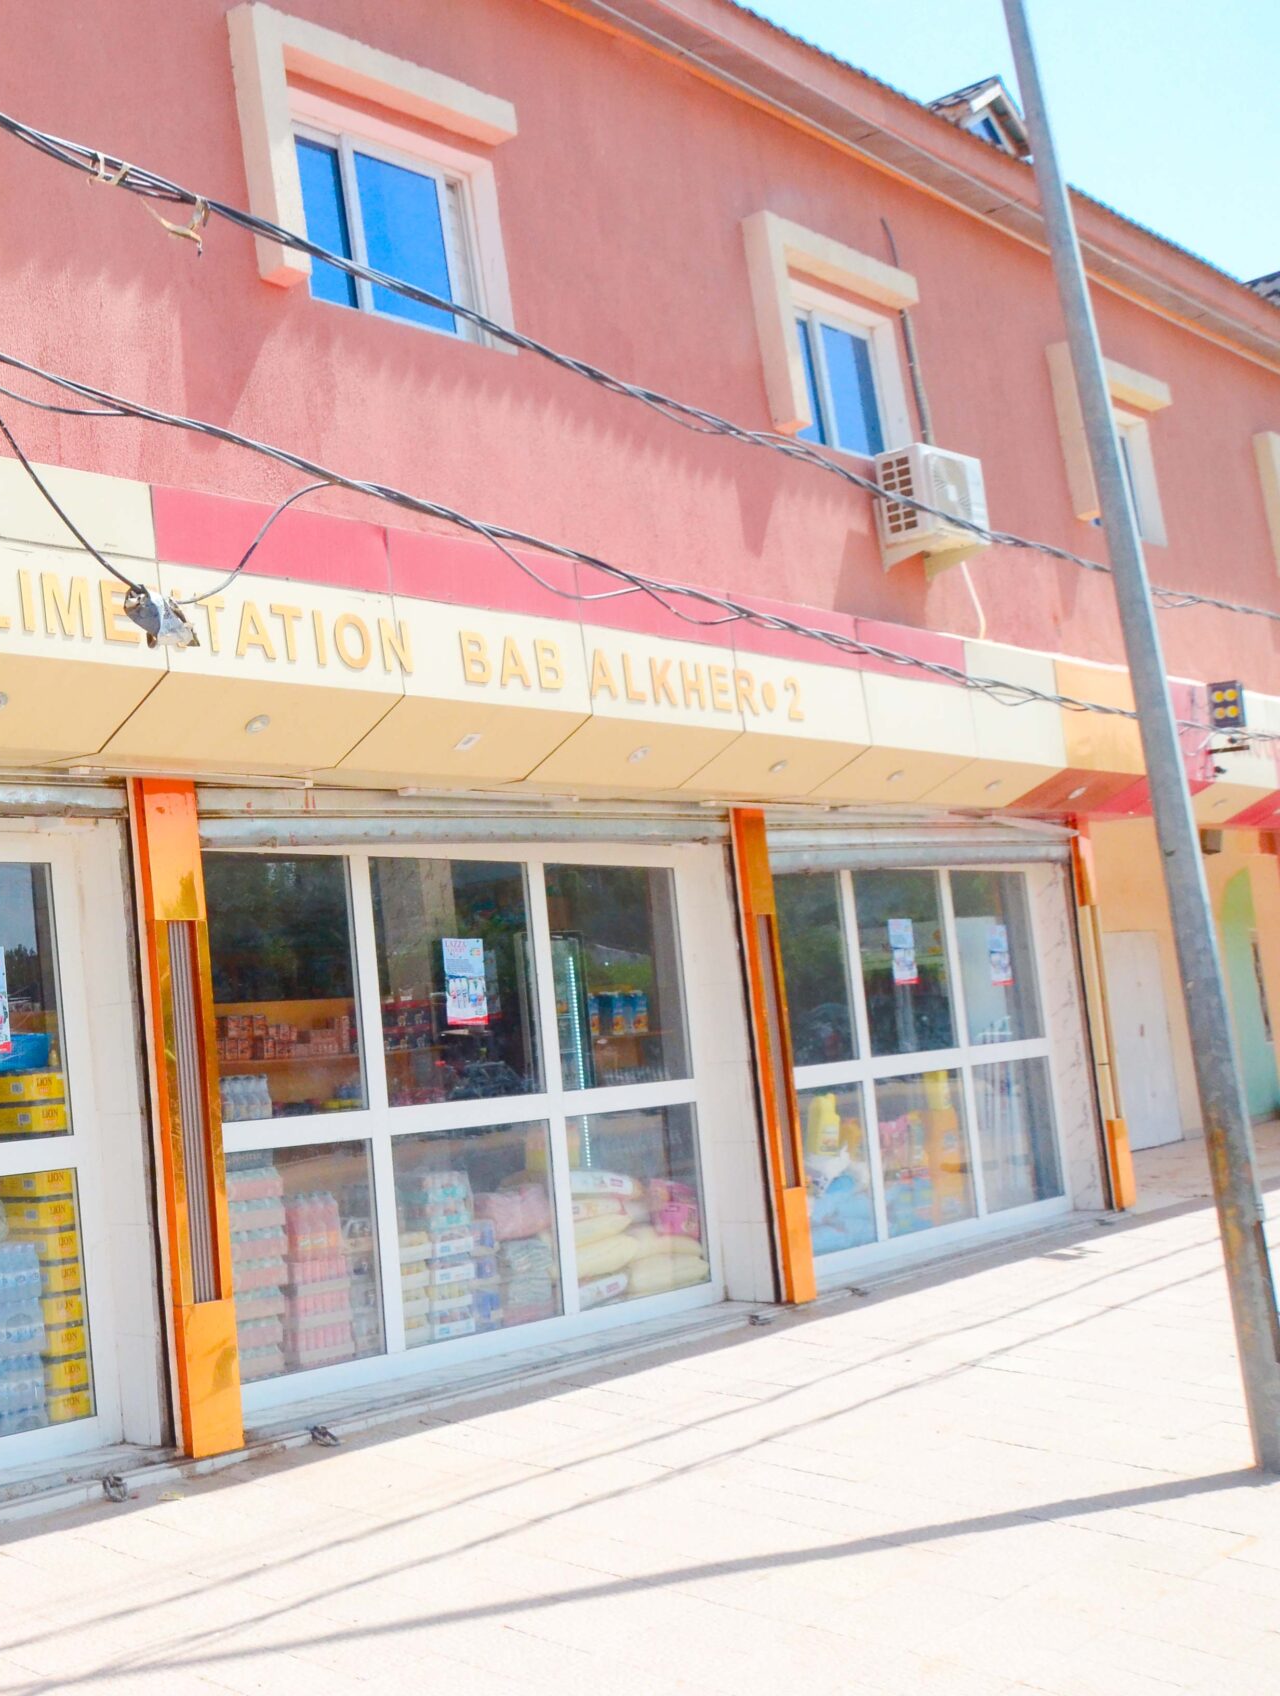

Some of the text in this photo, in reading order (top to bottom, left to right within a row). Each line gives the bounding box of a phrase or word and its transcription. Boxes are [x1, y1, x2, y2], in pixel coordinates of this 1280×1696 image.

[459, 630, 565, 690] BAB
[590, 648, 760, 716] ALKHER
[36, 1077, 53, 1087] LION
